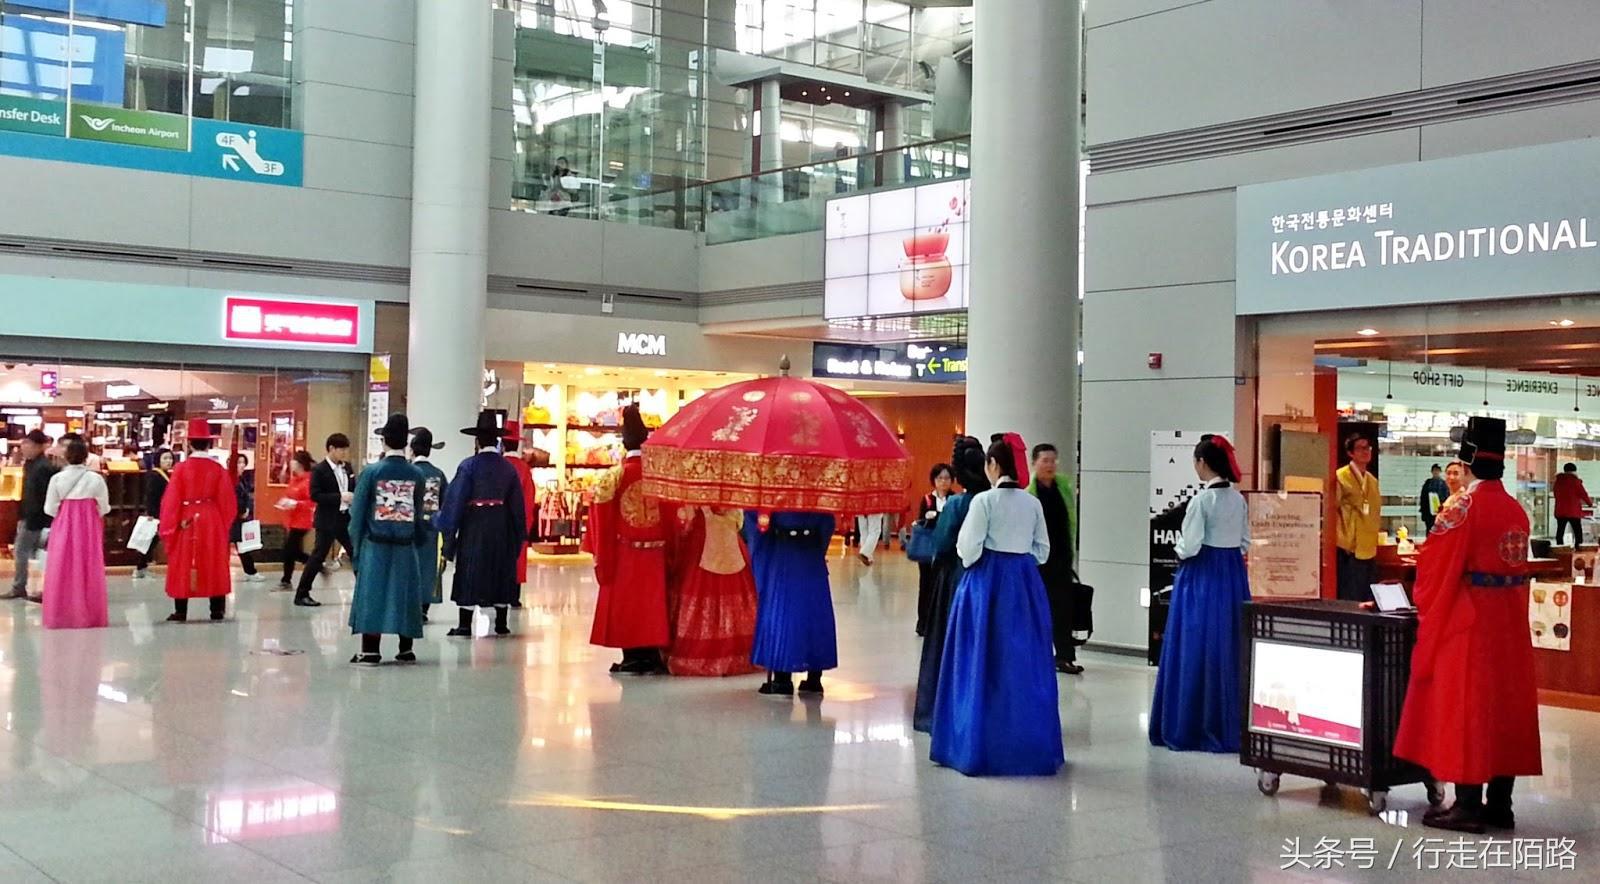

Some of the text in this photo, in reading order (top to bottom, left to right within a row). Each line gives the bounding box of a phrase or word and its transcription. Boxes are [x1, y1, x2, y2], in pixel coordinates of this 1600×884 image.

[31, 110, 60, 125] Desk
[112, 124, 179, 139] Incheon Airport
[221, 135, 235, 146] 4F
[264, 162, 277, 173] 3F
[1271, 202, 1393, 233] 한국전통문화센터
[1271, 218, 1598, 275] KOREA TRADITIONAL
[617, 332, 666, 356] MCM
